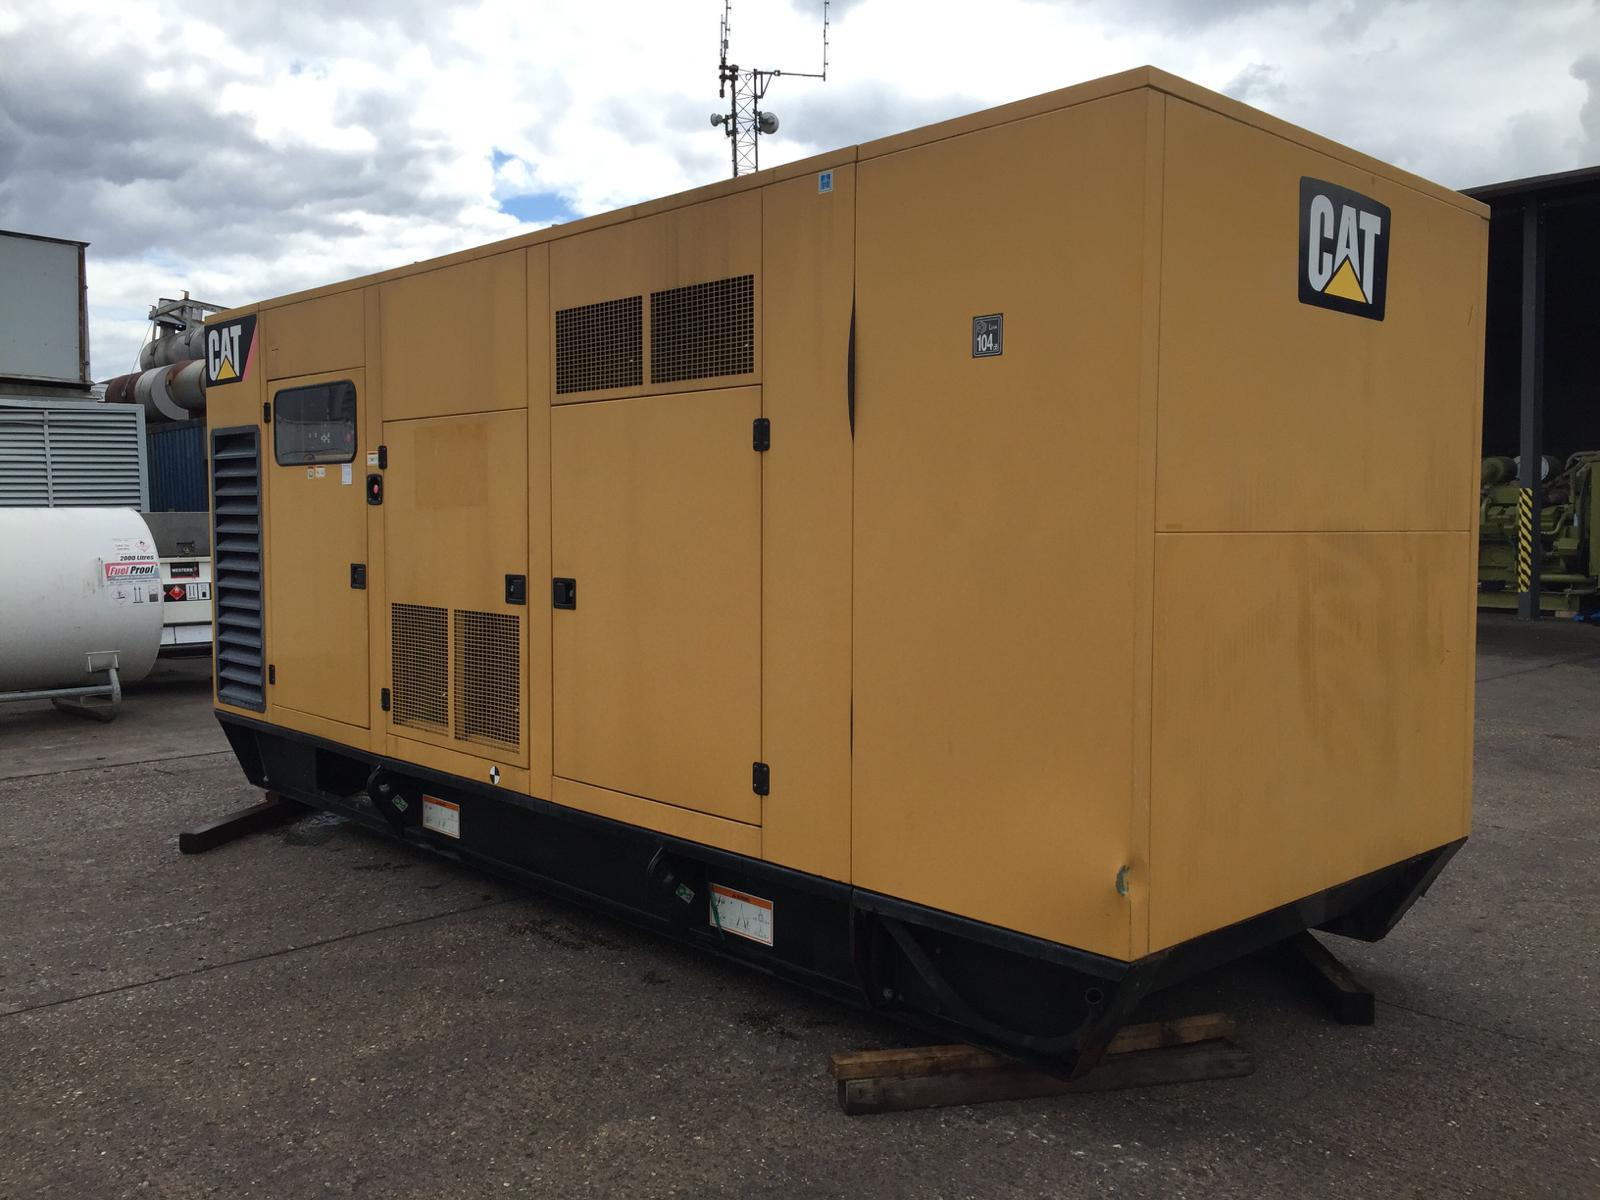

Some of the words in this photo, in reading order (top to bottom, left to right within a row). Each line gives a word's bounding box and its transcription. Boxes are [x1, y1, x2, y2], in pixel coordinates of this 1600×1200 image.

[1308, 194, 1382, 305] CAT
[208, 324, 242, 381] CAT
[976, 333, 993, 352] 104
[110, 566, 129, 576] Fuel
[130, 566, 154, 575] Proof
